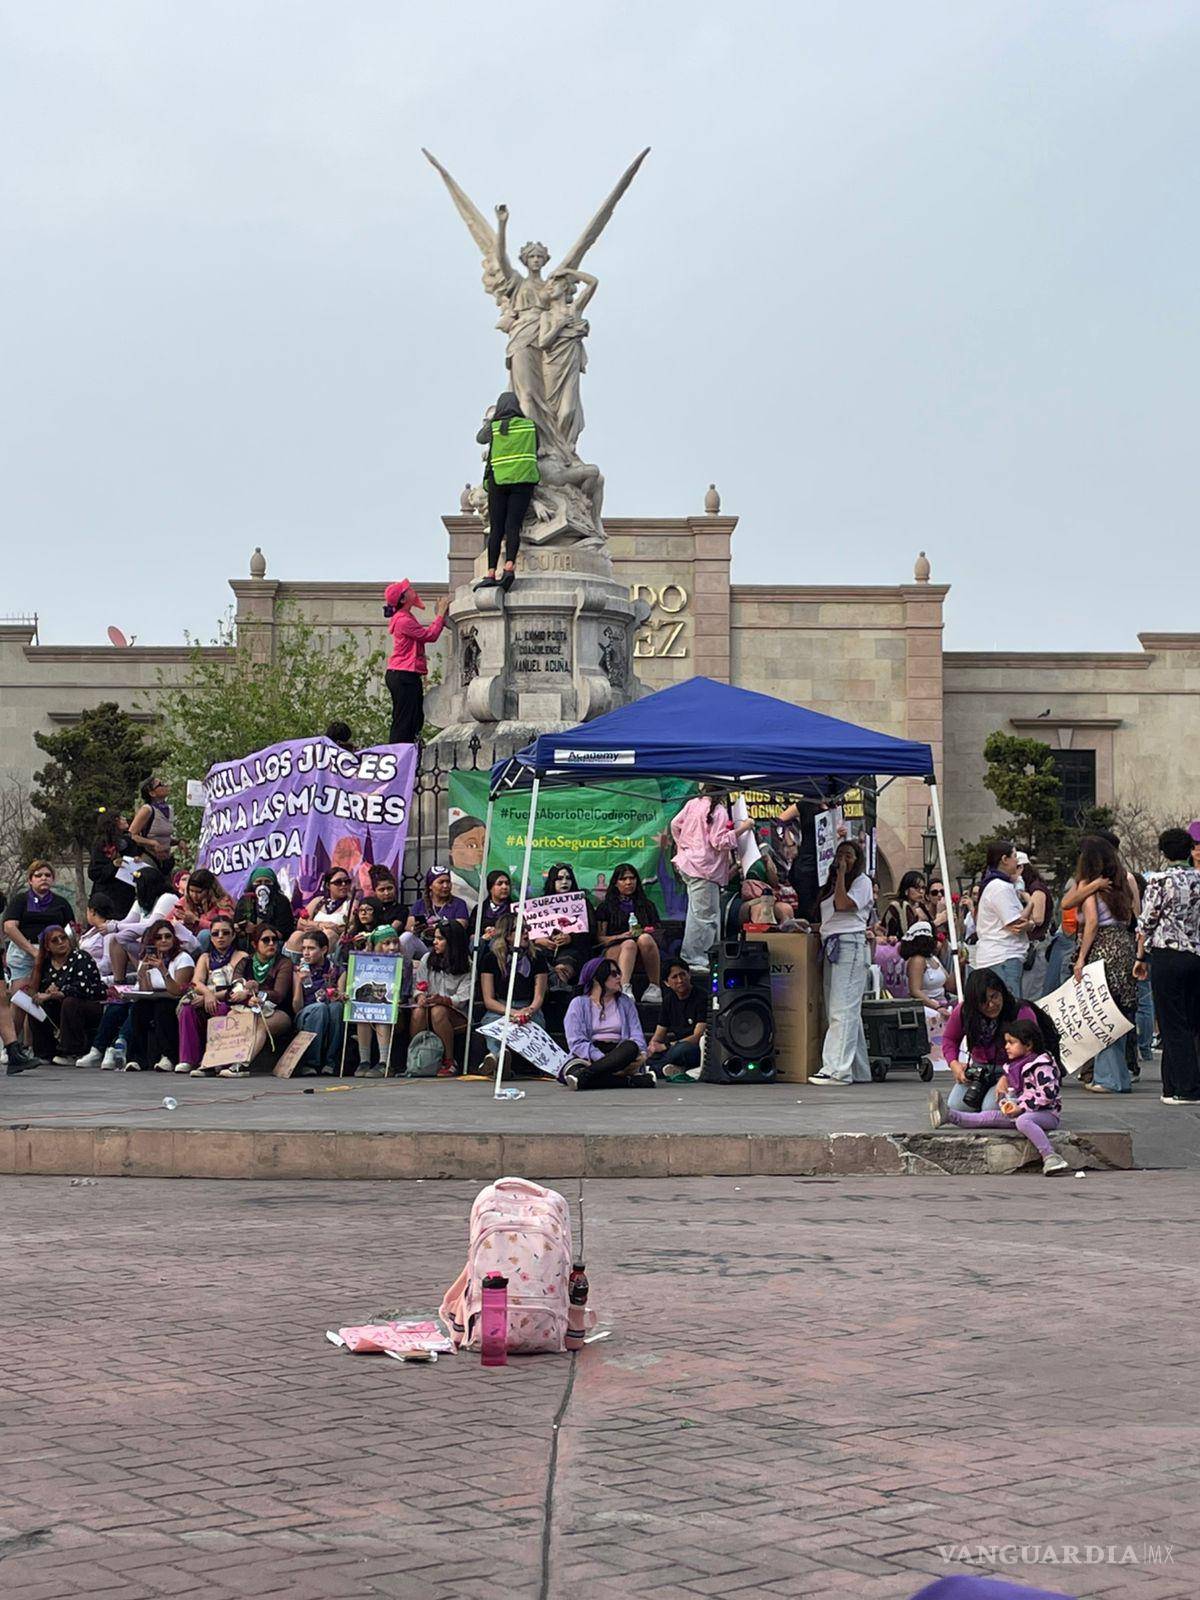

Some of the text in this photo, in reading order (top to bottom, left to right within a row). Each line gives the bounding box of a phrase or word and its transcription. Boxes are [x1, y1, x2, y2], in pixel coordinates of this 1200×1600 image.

[568, 752, 620, 762] Academy
[255, 749, 292, 786] LOS
[233, 803, 248, 833] A
[506, 835, 645, 851] #AortoSeguroEsSalud
[771, 964, 794, 973] NY
[1082, 973, 1116, 1033] COAHUILA
[1097, 983, 1111, 1003] EN
